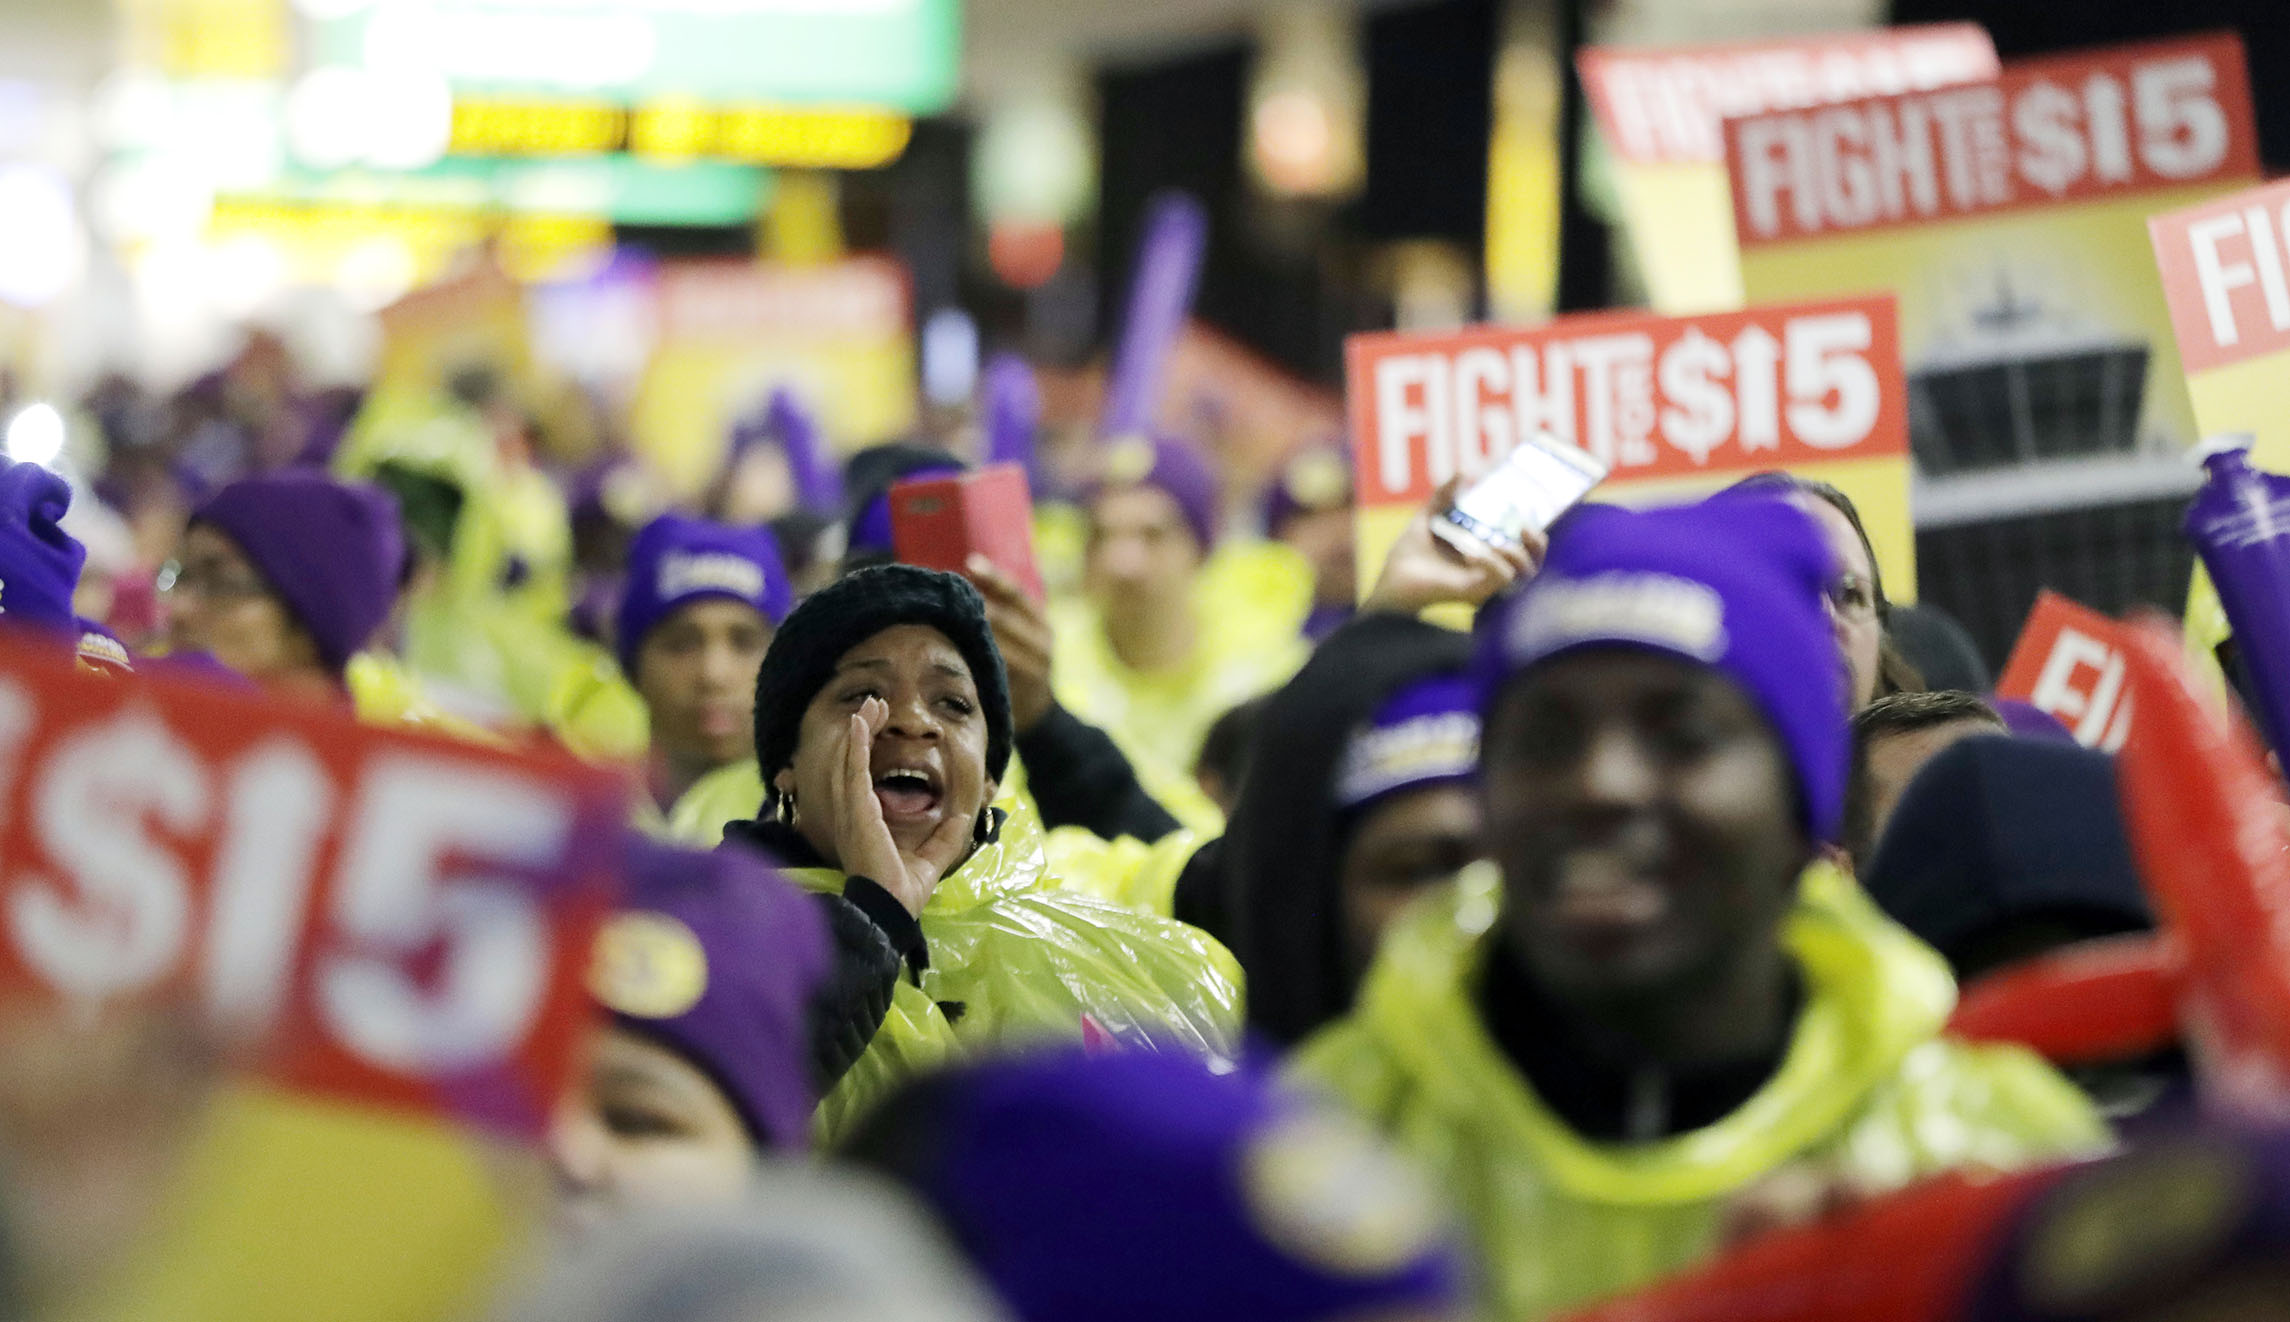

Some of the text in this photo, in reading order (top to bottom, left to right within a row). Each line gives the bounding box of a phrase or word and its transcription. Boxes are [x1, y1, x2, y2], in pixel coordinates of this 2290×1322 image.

[1738, 88, 2000, 237] FIGHT
[2013, 56, 2228, 195] $15
[2189, 203, 2290, 347] FI
[1375, 335, 1654, 493] FIGHT
[1659, 311, 1880, 466] $15
[8, 702, 567, 1070] $15
